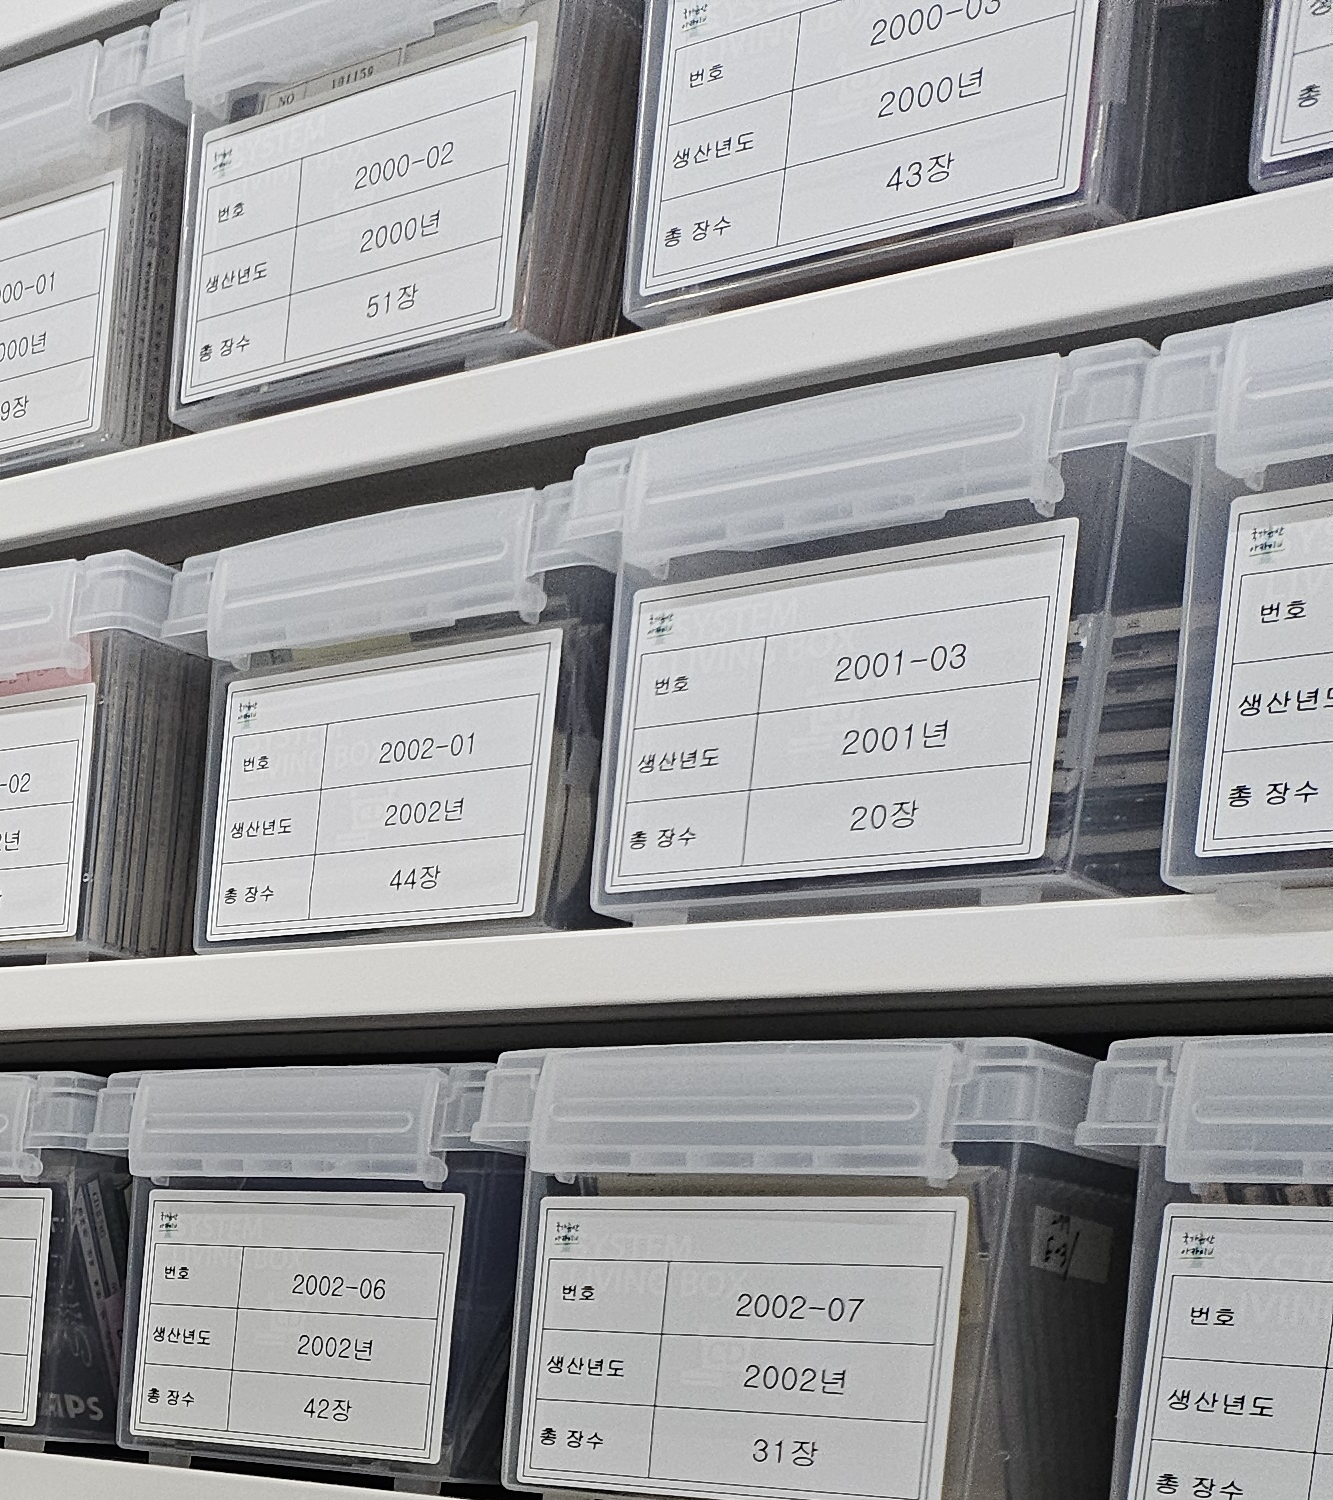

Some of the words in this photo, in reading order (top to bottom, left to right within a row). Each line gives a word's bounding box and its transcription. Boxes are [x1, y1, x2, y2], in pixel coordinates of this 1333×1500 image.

[878, 66, 983, 118] 2000년
[354, 141, 454, 190] 2000-02
[886, 152, 955, 191] 43장
[360, 210, 440, 253] 2000년
[367, 283, 419, 318] 51장
[1261, 600, 1307, 624] 번호
[655, 676, 689, 696] 번호
[834, 643, 967, 682] 2001-03
[378, 732, 475, 764] 2002-01
[637, 748, 719, 774] 생산년도
[841, 720, 948, 755] 2001년
[1228, 784, 1252, 808] 총
[1265, 781, 1320, 806] 장수
[384, 797, 465, 826] 2002년
[629, 830, 647, 850] 총
[658, 827, 697, 848] 장수
[849, 799, 919, 831] 20장
[390, 865, 441, 891] 44장
[292, 1274, 386, 1300] 2002-06
[562, 1284, 595, 1301] 번호
[736, 1293, 865, 1323] 2002-07
[1189, 1306, 1236, 1327] 번호
[297, 1334, 373, 1361] 2002년
[547, 1355, 624, 1377] 생산년도
[743, 1364, 846, 1395] 2002년
[304, 1398, 352, 1422] 42장
[1167, 1388, 1275, 1418] 생산년도
[540, 1427, 557, 1446] 총
[567, 1430, 604, 1450] 장수
[752, 1438, 819, 1467] 31장
[1156, 1473, 1180, 1495] 총
